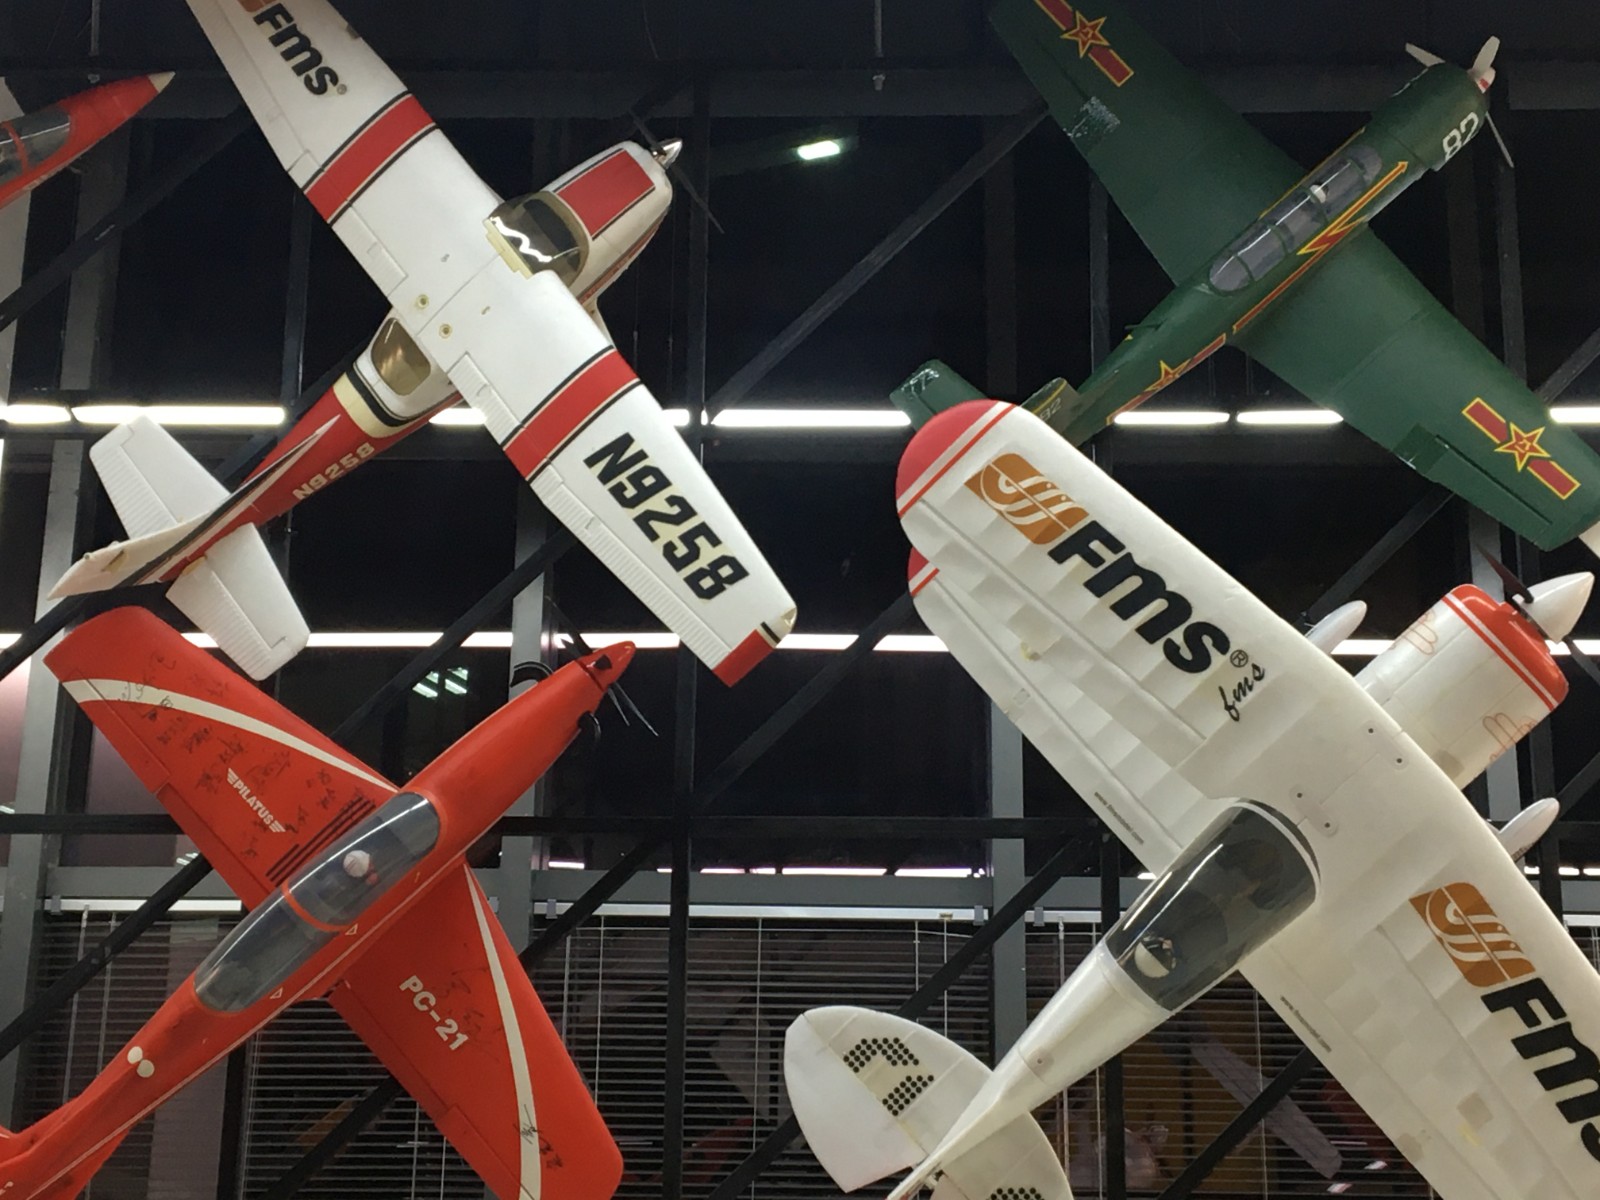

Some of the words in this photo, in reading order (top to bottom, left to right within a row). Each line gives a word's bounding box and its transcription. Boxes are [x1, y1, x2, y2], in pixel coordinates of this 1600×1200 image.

[1442, 111, 1479, 161] 82
[292, 442, 375, 500] N9258
[583, 432, 750, 600] N9258
[233, 779, 273, 825] PILATUS
[399, 975, 468, 1051] PC-21
